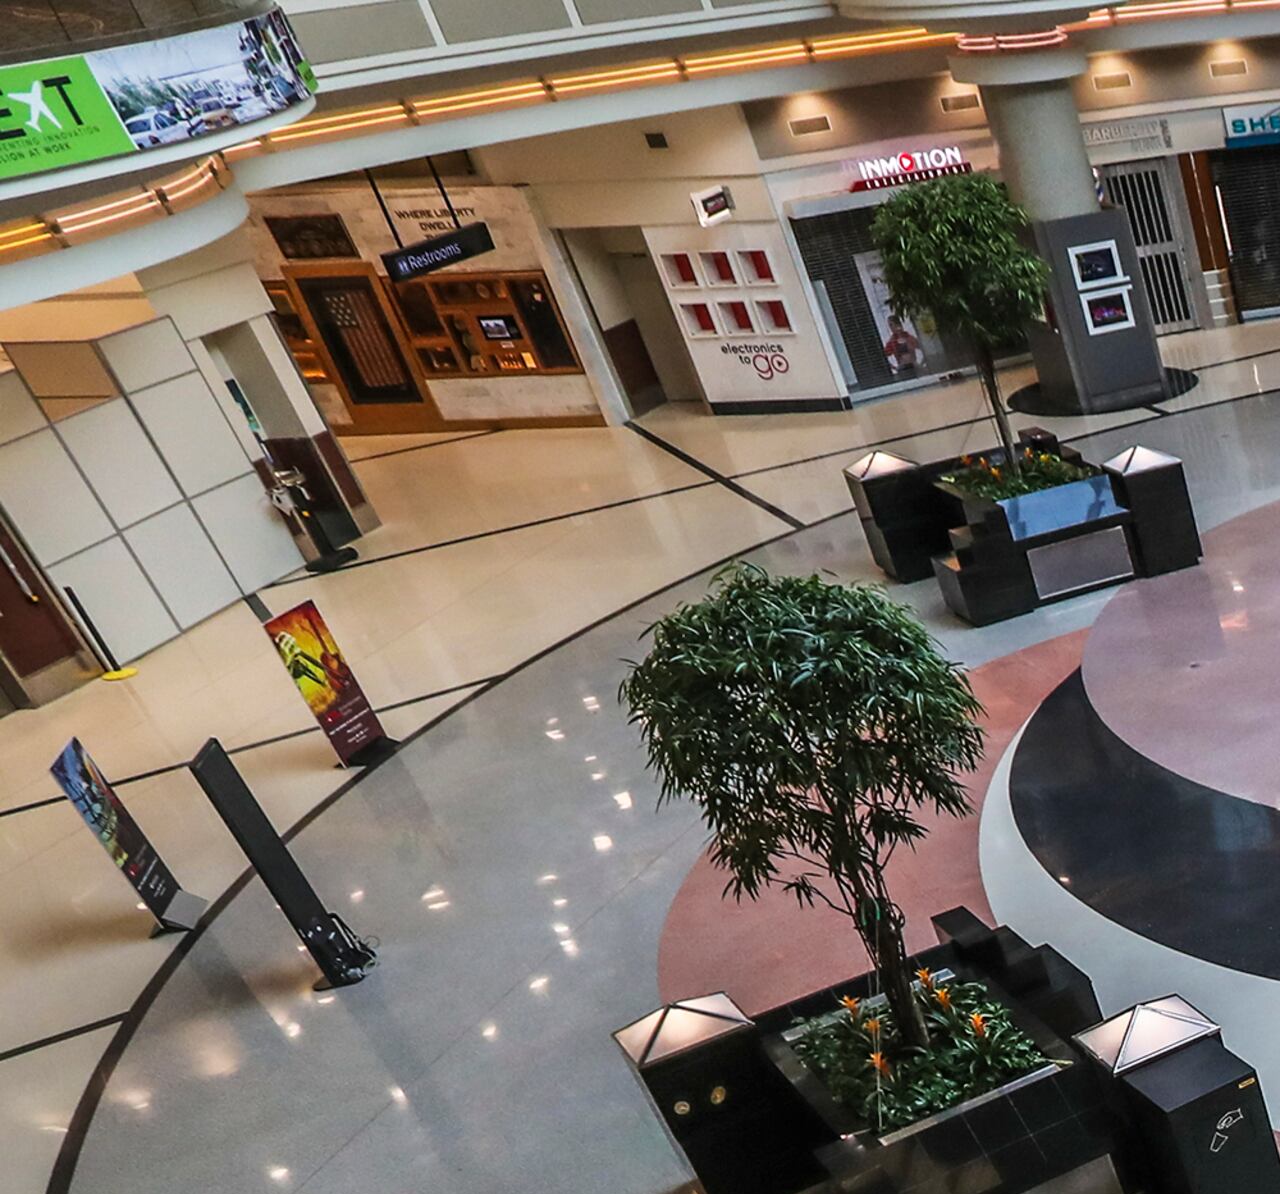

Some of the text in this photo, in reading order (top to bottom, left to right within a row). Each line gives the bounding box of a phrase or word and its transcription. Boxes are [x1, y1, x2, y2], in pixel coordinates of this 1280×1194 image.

[858, 146, 963, 180] INMOTION
[395, 207, 477, 220] WHERE LIBRTY
[408, 242, 462, 270] Restrooms
[721, 343, 784, 355] electronics
[739, 353, 789, 381] to go
